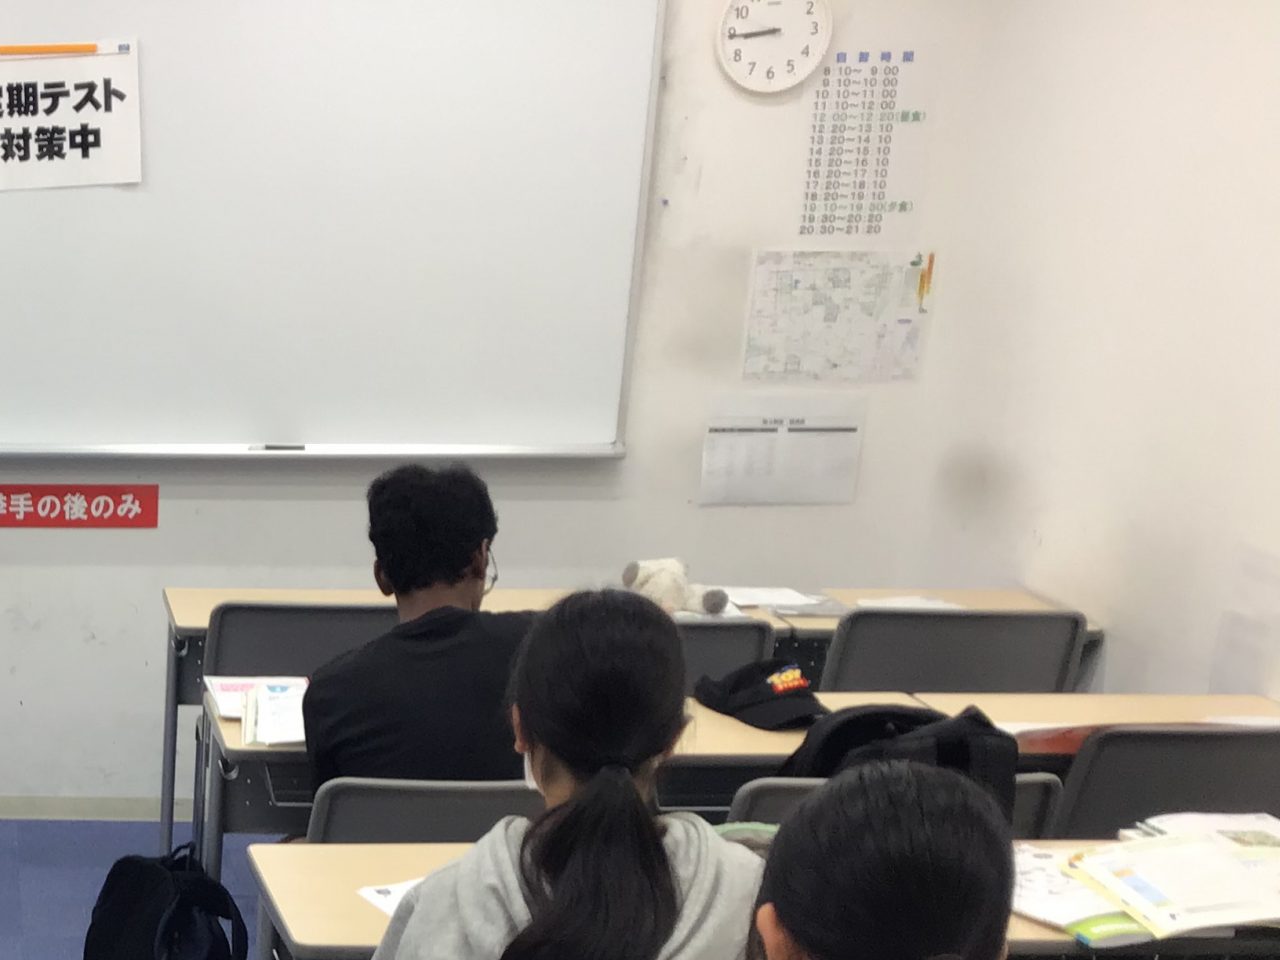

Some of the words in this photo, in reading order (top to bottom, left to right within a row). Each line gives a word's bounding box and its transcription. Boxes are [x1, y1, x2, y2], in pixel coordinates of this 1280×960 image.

[734, 5, 749, 20] 10
[805, 1, 814, 15] 2
[810, 21, 819, 36] 3
[733, 48, 742, 62] 8
[801, 44, 810, 57] 4
[748, 61, 757, 76] 7
[766, 66, 775, 80] 6
[786, 59, 795, 74] 5
[0, 123, 102, 163] 対策中
